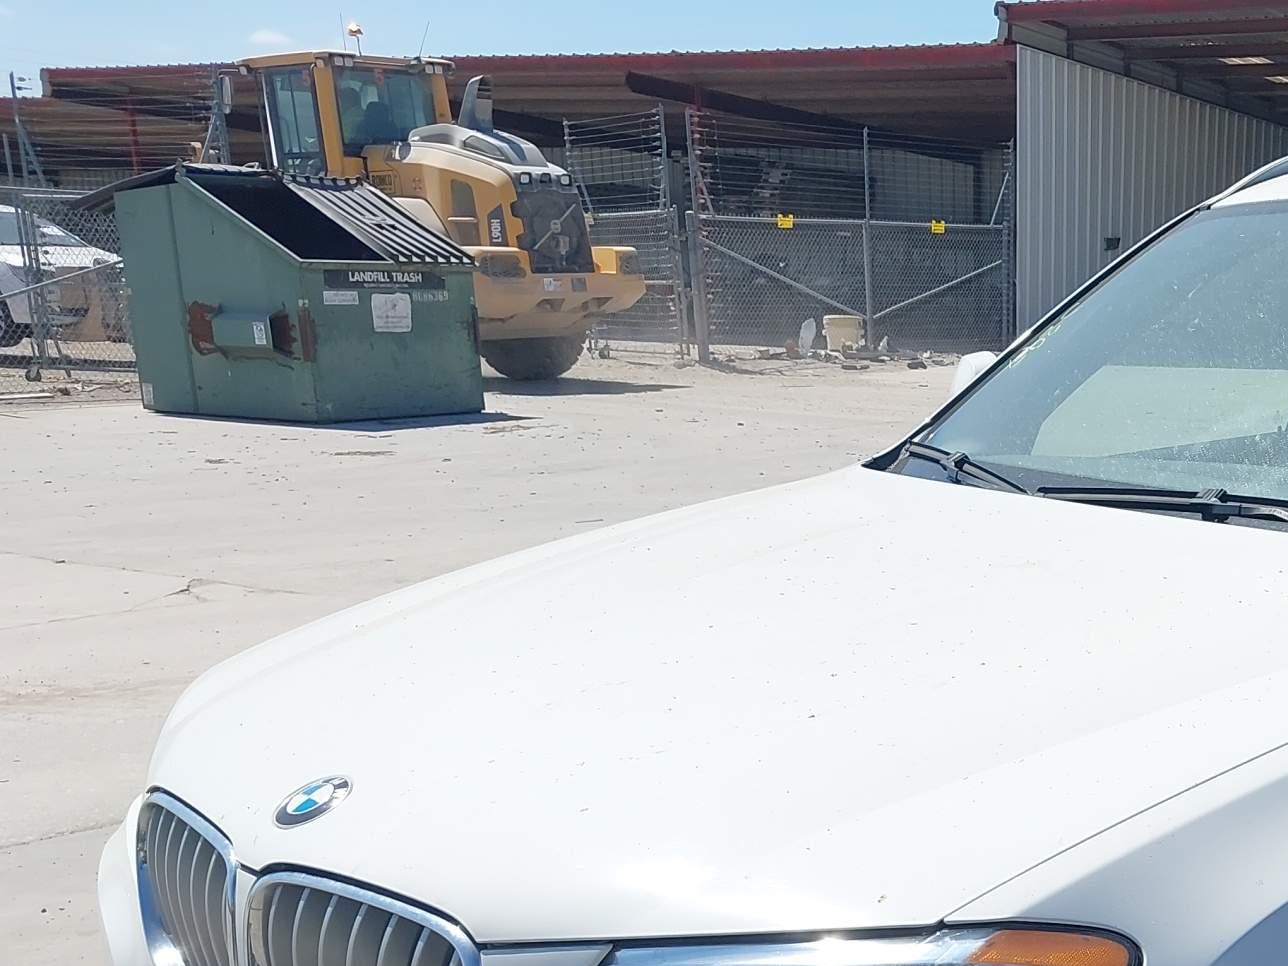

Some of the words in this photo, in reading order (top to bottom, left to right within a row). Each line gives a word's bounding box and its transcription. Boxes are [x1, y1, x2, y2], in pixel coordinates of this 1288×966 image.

[490, 218, 502, 243] L90H
[348, 271, 390, 282] LANDFILL
[391, 271, 422, 283] TRASH
